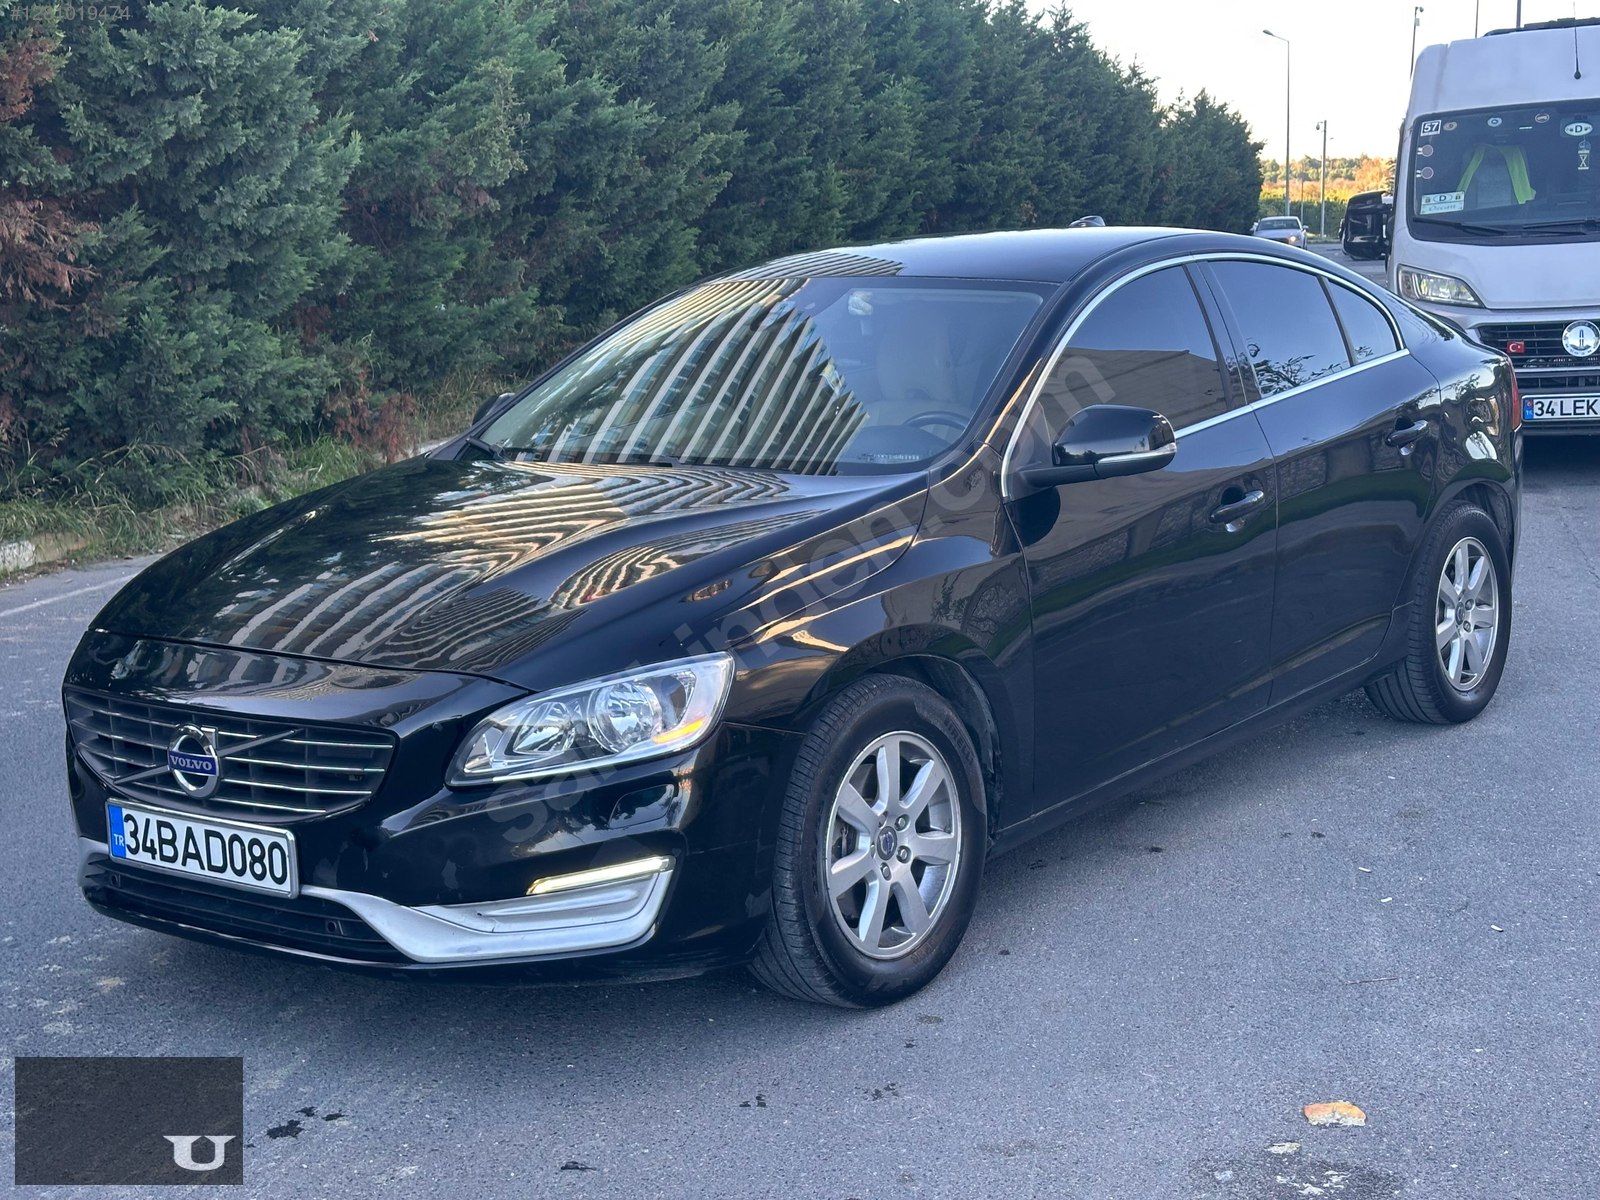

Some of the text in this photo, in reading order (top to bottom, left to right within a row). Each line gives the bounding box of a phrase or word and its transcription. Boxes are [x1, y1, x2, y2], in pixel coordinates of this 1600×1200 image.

[1422, 121, 1439, 134] 57
[1574, 124, 1583, 134] D
[1534, 399, 1599, 417] 34 LEK
[170, 754, 213, 771] VOLVO
[113, 833, 125, 848] TR
[124, 813, 288, 885] 34BAD080
